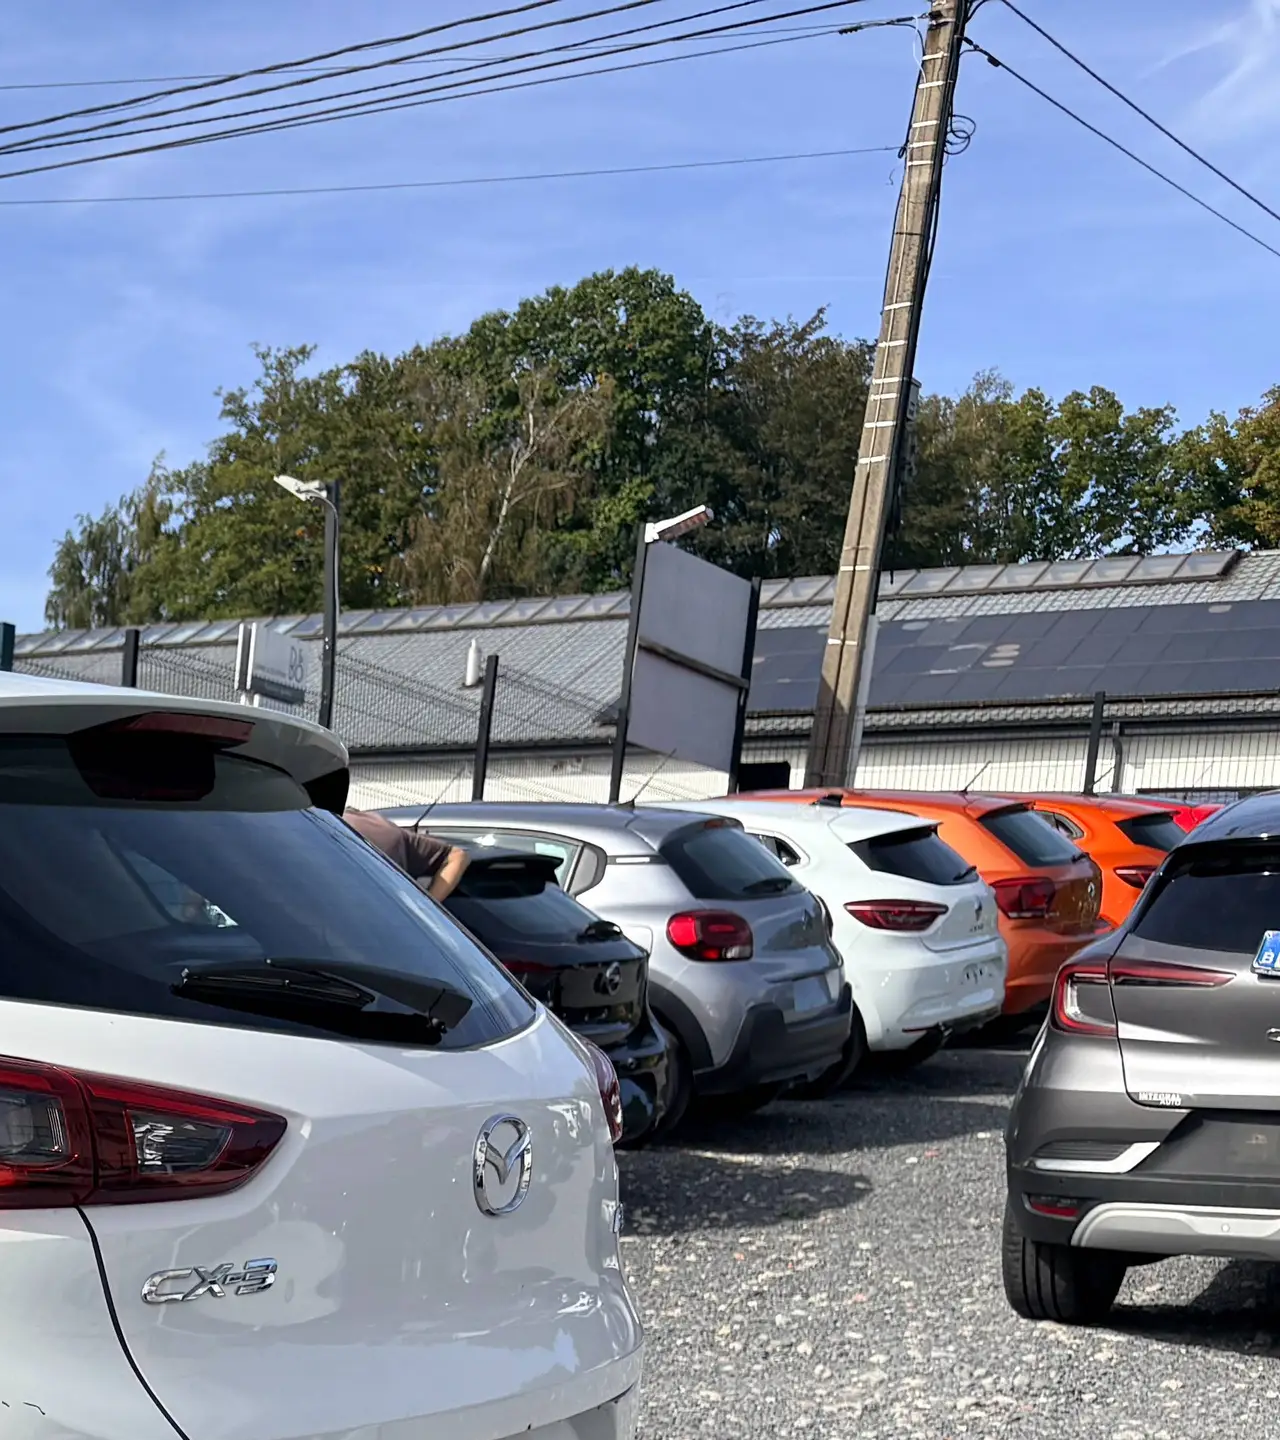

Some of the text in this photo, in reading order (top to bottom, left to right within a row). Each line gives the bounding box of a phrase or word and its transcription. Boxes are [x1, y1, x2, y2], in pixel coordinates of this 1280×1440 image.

[1139, 1092, 1181, 1101] INTEGRAL
[1159, 1098, 1182, 1106] AUTO
[141, 1257, 278, 1305] CX-3
